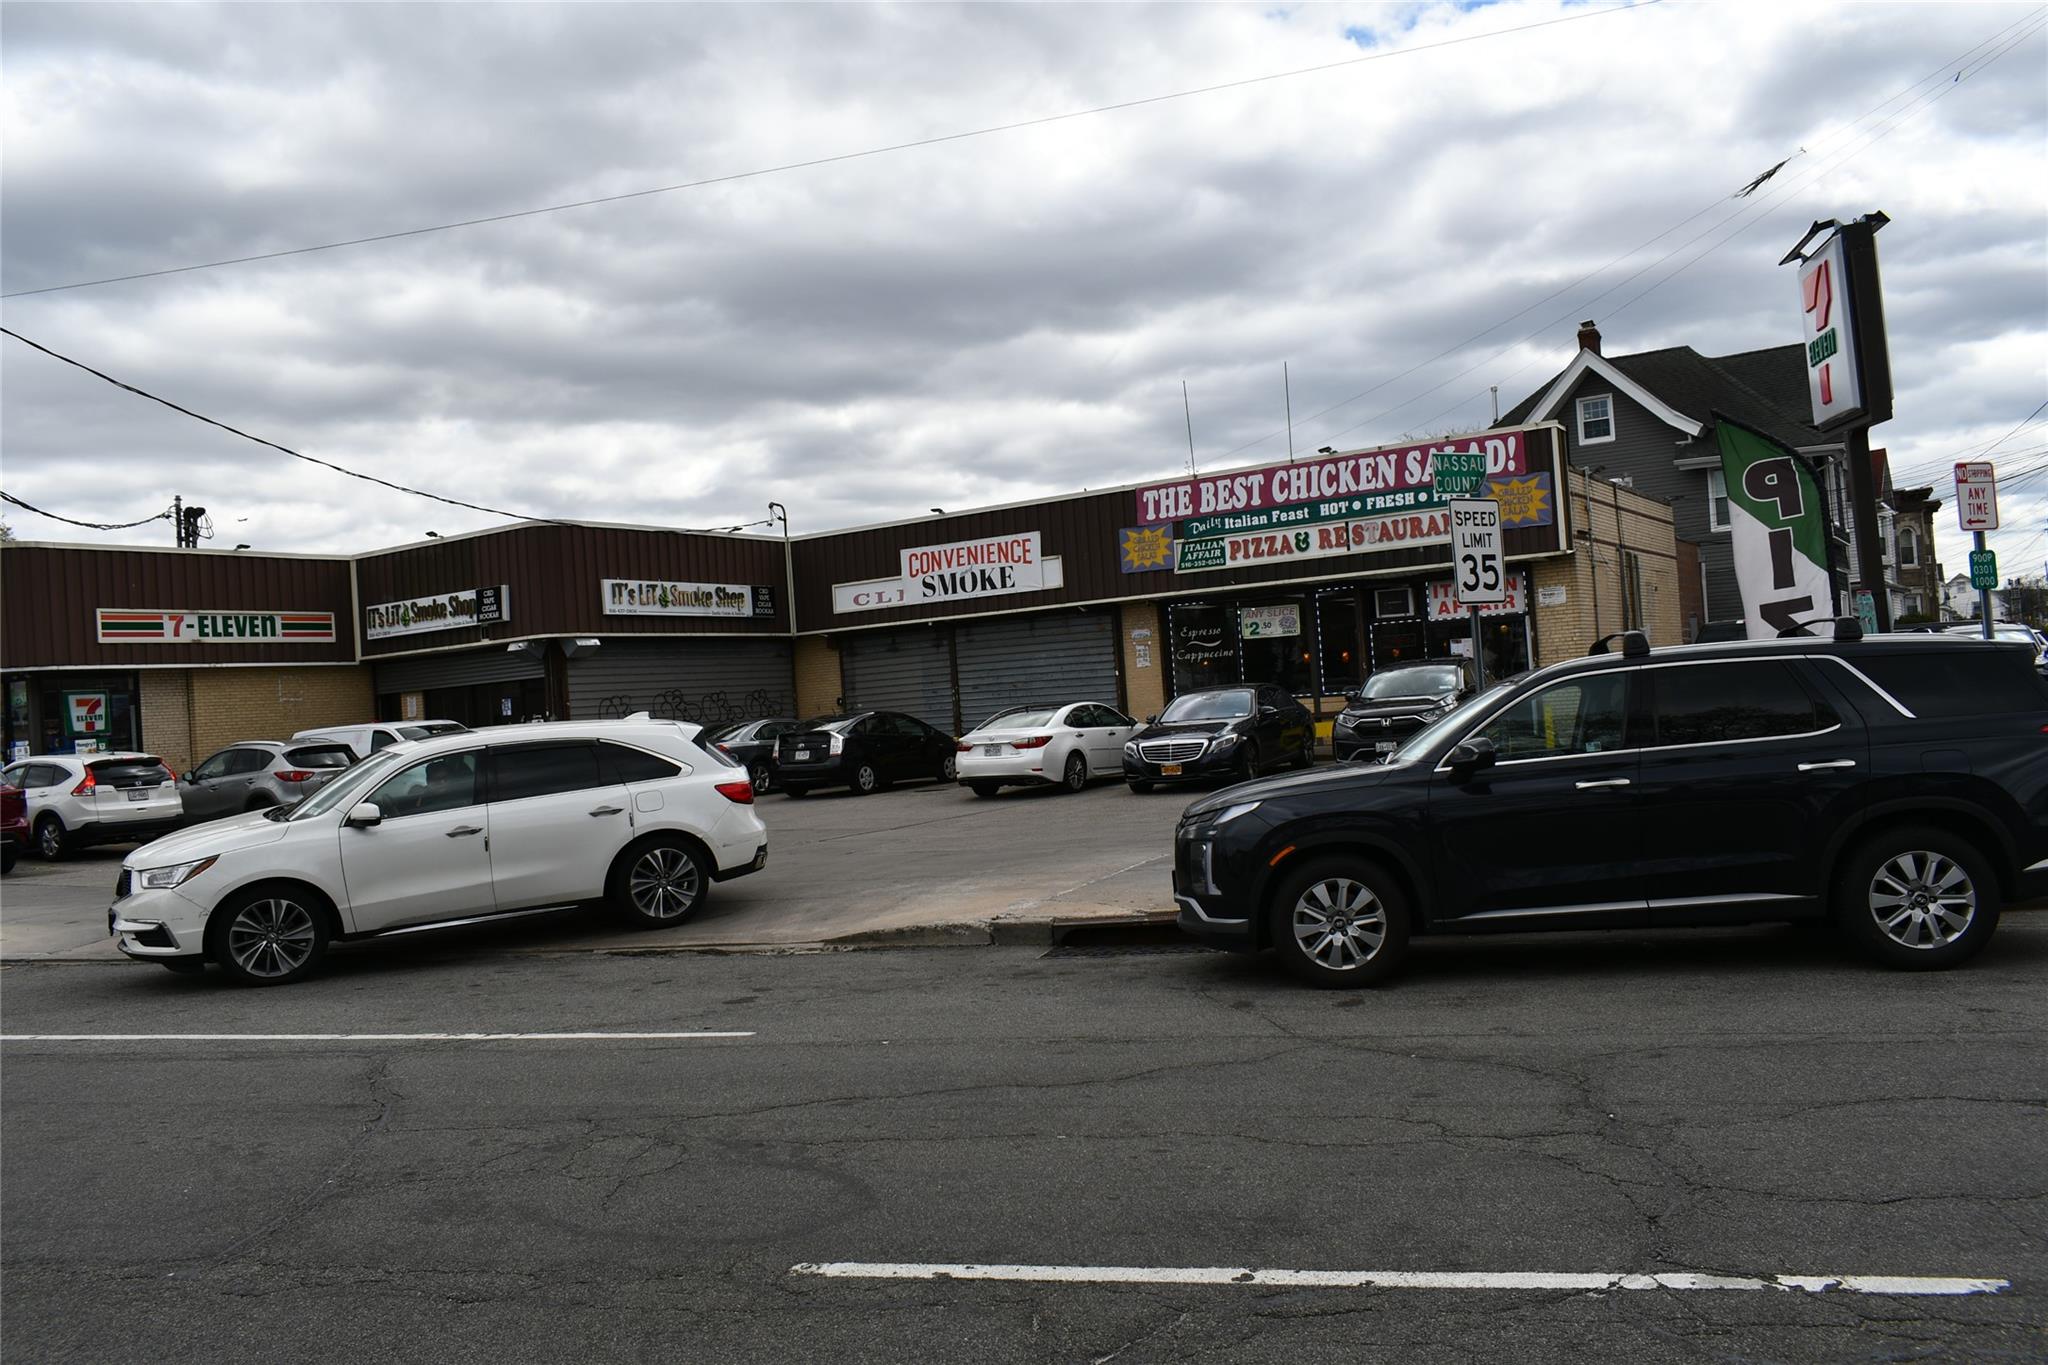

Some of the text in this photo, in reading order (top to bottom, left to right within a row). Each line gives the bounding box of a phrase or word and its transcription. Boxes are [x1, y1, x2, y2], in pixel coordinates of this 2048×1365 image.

[1433, 456, 1485, 471] NASSAU
[1957, 467, 1992, 480] NO STOPPING
[1143, 485, 1193, 521] THE
[1200, 473, 1264, 514] BEST
[1272, 453, 1398, 503] CHICKEN
[1968, 488, 1986, 499] ANY
[1189, 516, 1221, 535] Daily
[1225, 514, 1268, 529] Italian
[1272, 507, 1309, 523] Feast
[1320, 501, 1349, 516] HOT
[1366, 492, 1415, 510] FRESH
[1968, 502, 1988, 515] TIME
[1455, 511, 1496, 527] SPEED
[1184, 540, 1225, 552] ITALIAN
[1462, 533, 1492, 548] LIMIT
[909, 538, 1032, 578] CONVENIENCE
[1185, 549, 1221, 561] AFFAIR
[1972, 553, 1993, 563] 900P
[1461, 554, 1499, 591] 35
[1973, 565, 1993, 574] 0301
[921, 565, 1015, 598] SMOKE
[1975, 576, 1995, 586] 1000
[670, 585, 713, 608] Smoke
[715, 586, 745, 611] Shop
[411, 598, 447, 623] Smoke
[448, 595, 476, 619] Shop
[1245, 607, 1295, 619] ANY SLICE
[1180, 626, 1221, 640] Espresso
[1176, 649, 1234, 663] Cappuccino
